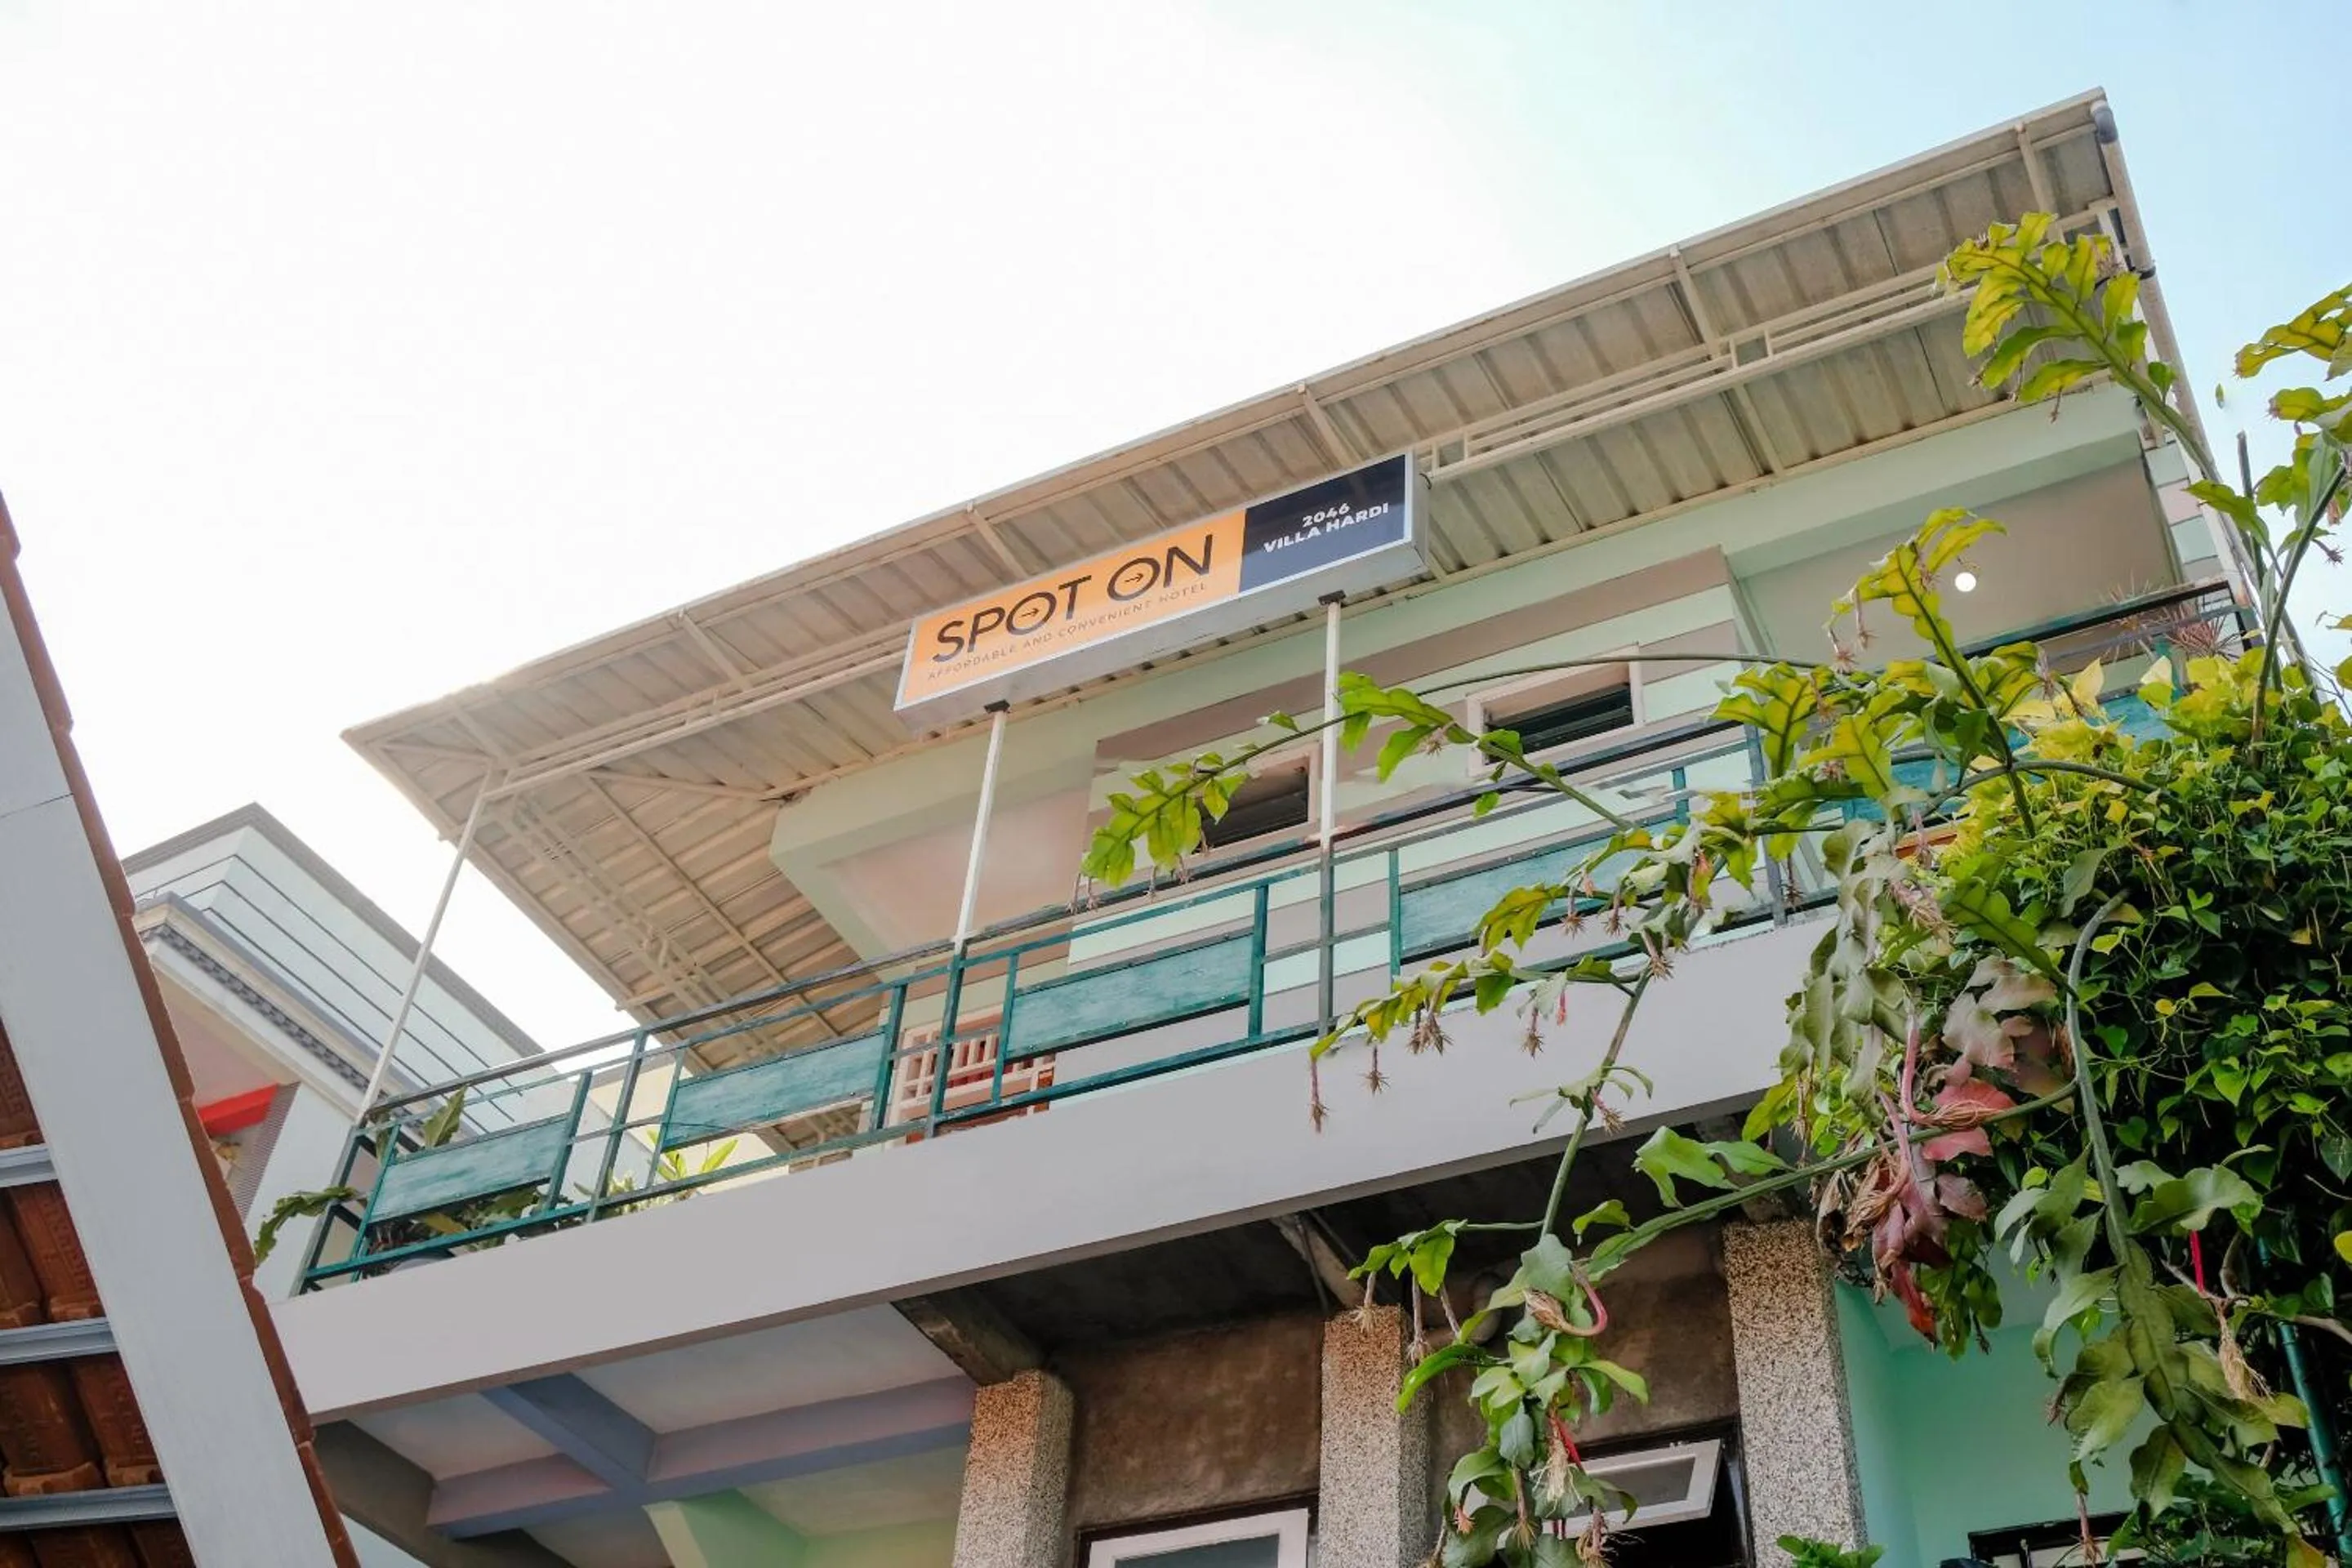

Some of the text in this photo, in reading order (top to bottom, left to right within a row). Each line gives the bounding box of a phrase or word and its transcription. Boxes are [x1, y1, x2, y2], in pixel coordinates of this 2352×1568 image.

[1263, 502, 1388, 553] VILLA HARDI
[1303, 502, 1351, 528] 2046
[928, 582, 1206, 680] AFFORDABLE AND CONVENIENT HOTEL
[933, 534, 1213, 662] SPOT ON
